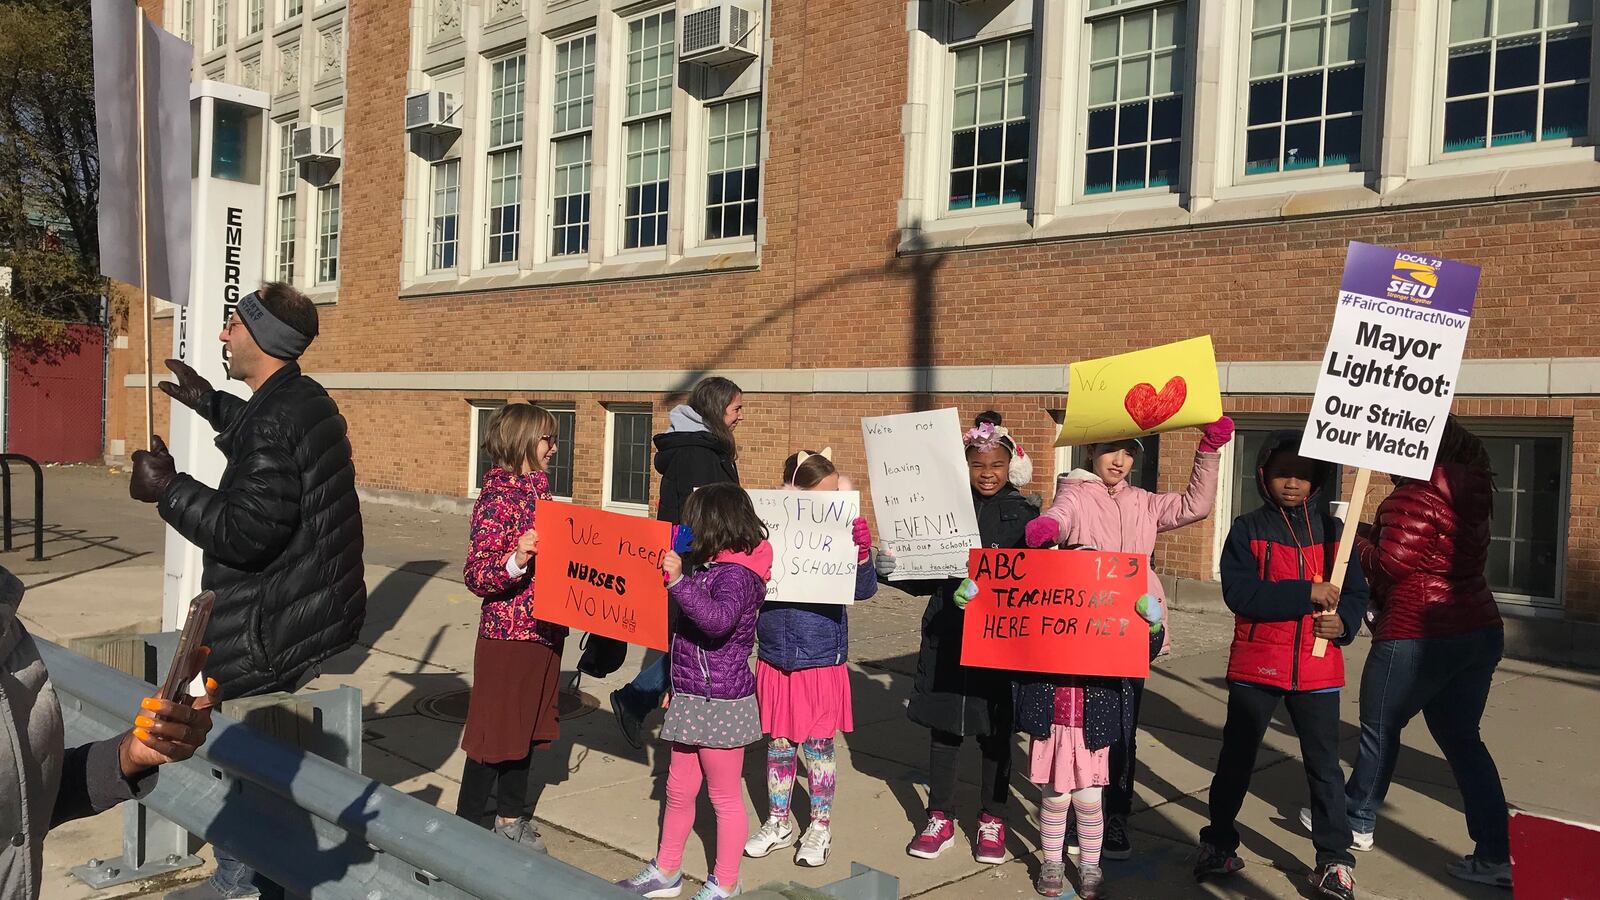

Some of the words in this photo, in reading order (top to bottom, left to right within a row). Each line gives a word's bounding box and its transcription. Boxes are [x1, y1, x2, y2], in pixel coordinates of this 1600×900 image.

[1396, 253, 1428, 265] LOCAL
[1430, 259, 1443, 268] 73
[1386, 280, 1436, 299] SEIU
[1386, 291, 1409, 301] Stronger
[1409, 296, 1433, 305] Together
[1341, 294, 1467, 330] #FairContractNow
[1355, 321, 1442, 360] Mayor
[1075, 362, 1113, 392] We
[1326, 351, 1450, 397] Lightfoot:
[865, 424, 893, 435] We're
[915, 420, 934, 431] not
[1325, 395, 1363, 420] Our
[1366, 403, 1436, 434] Strike/
[1315, 420, 1361, 446] Your
[1365, 430, 1429, 461] Watch
[883, 461, 921, 476] leaving
[796, 498, 859, 528] FUND
[884, 495, 900, 507] till
[909, 492, 925, 504] it's
[565, 517, 602, 546] We
[794, 530, 833, 552] OUR
[567, 560, 626, 596] NURSES
[975, 552, 1026, 581] ABC
[991, 588, 1087, 609] TEACHERS
[983, 614, 1031, 640] HERE
[1041, 616, 1078, 636] FOR
